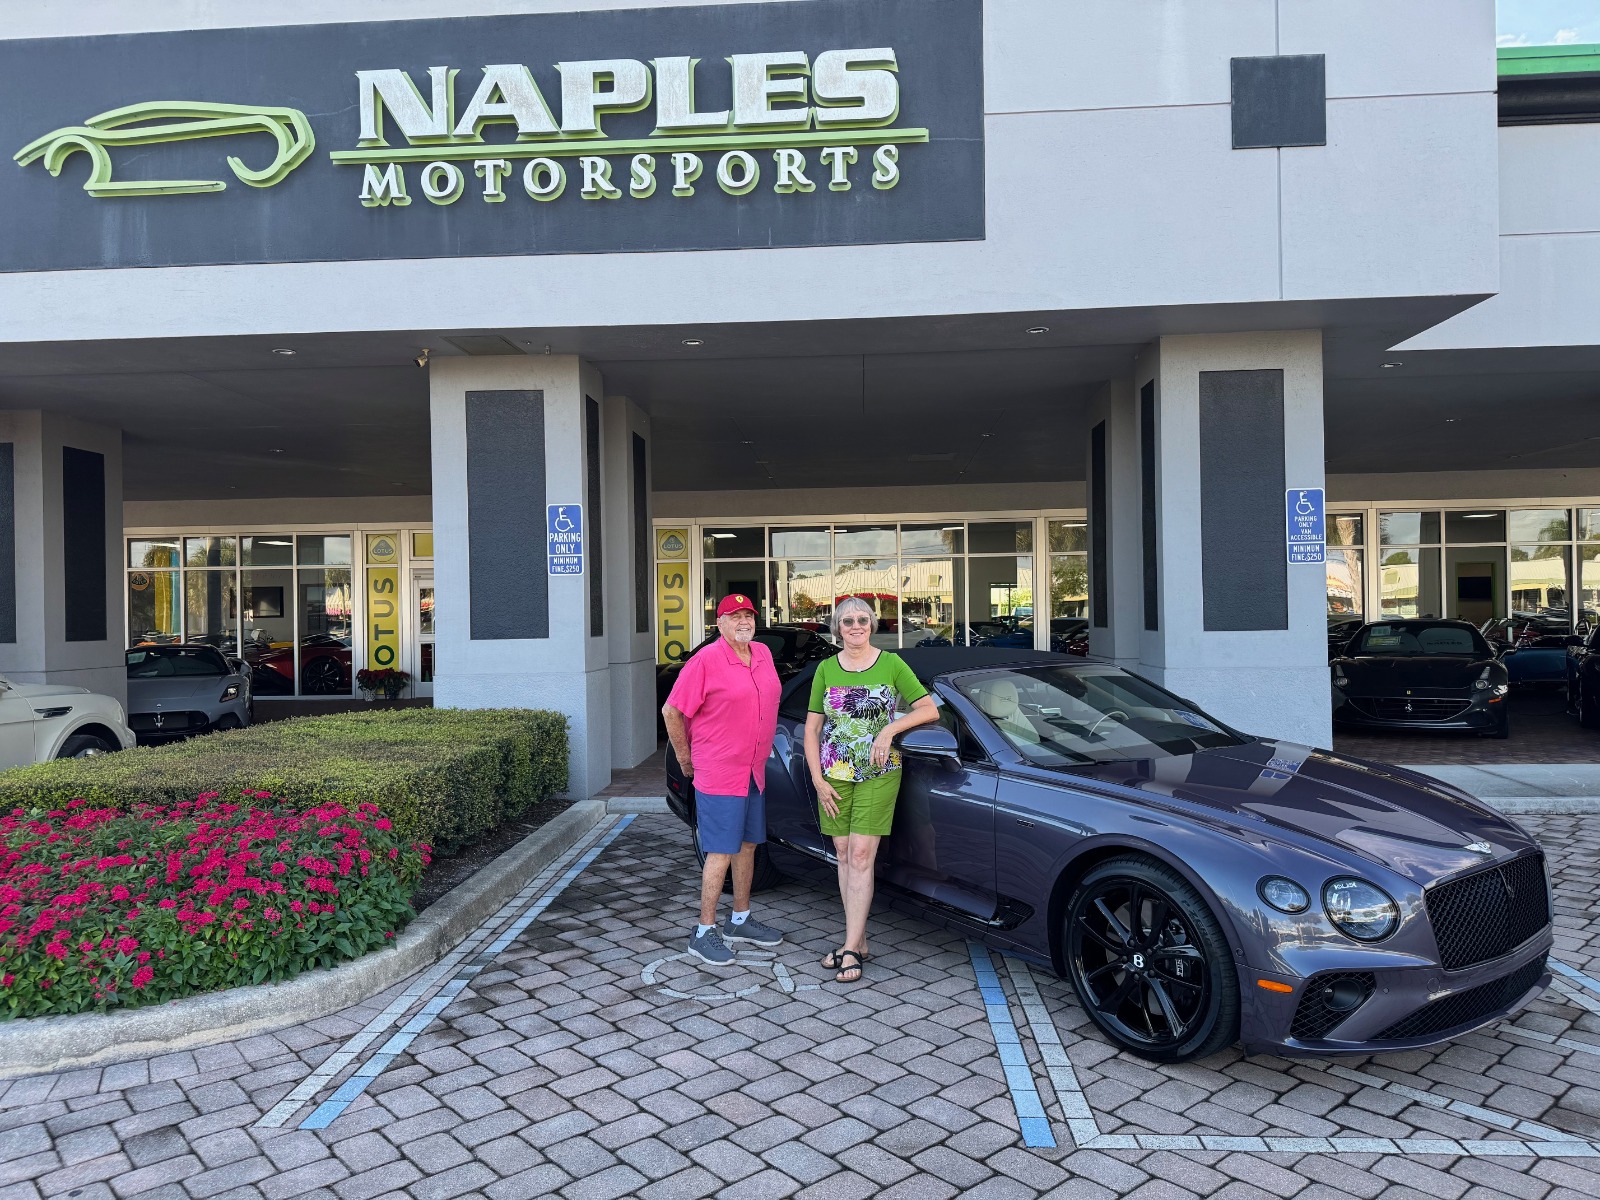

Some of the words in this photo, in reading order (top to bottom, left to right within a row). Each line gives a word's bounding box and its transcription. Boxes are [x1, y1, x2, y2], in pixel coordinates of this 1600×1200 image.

[355, 46, 900, 147] NAPLES
[358, 144, 901, 207] MOTORSPORTS
[549, 532, 580, 542] PARKING
[556, 544, 575, 553] ONLY
[373, 577, 395, 669] OTUS
[663, 572, 685, 661] OTUS
[1133, 954, 1144, 968] B
